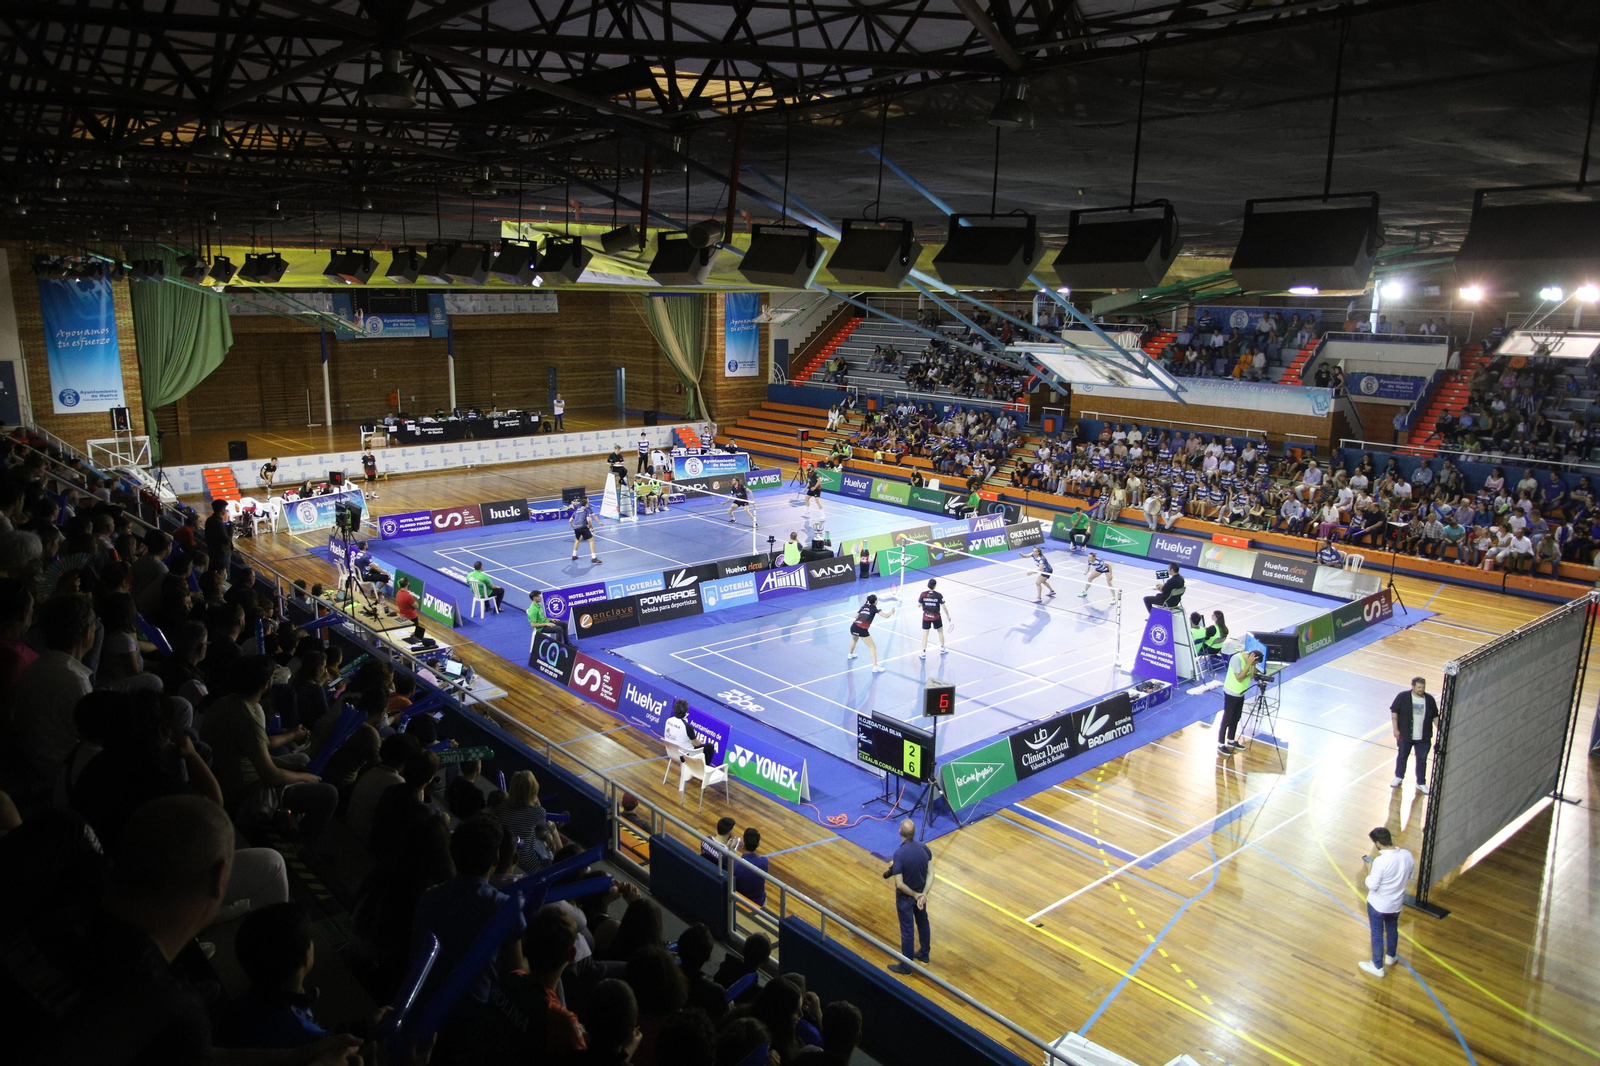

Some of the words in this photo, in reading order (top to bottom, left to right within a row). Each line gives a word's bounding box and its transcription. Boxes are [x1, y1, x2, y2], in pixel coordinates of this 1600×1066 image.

[56, 328, 110, 341] Apoyamos
[58, 340, 70, 348] tu
[72, 338, 110, 351] esfuerzo
[760, 474, 780, 484] YONEX
[844, 478, 867, 489] Huelva
[490, 506, 521, 519] bucle
[945, 525, 968, 534] LOTERÍAS
[1010, 528, 1039, 539] OKEYMAS
[983, 535, 1006, 548] YONEX
[1155, 538, 1192, 555] Huelva
[725, 566, 747, 574] Huelva
[811, 563, 852, 577] VANDA
[1264, 561, 1289, 572] Huelva
[1274, 571, 1305, 584] sentidos.
[626, 578, 662, 591] LOTERÍAS
[720, 580, 754, 592] LOTERÍAS
[568, 598, 588, 607] ALONSO
[588, 595, 607, 604] PINZÓN
[640, 589, 697, 606] POWERADE
[434, 597, 453, 619] YONEX
[593, 606, 633, 619] enclave
[642, 605, 658, 614] bebida
[658, 605, 670, 613] para
[670, 599, 697, 610] deportistas
[1305, 636, 1332, 654] IBERDROLA
[1141, 651, 1157, 660] ALONSO
[1158, 656, 1174, 665] PINZÓN
[1156, 648, 1173, 659] MARTÍN
[625, 683, 662, 716] Huelva
[939, 694, 949, 708] 6
[646, 712, 660, 724] original
[1114, 716, 1132, 726] ESPAÑA
[690, 720, 716, 738] Ayuntamiento
[889, 728, 902, 738] SILVA
[1088, 722, 1134, 749] BADMINTON
[909, 746, 915, 757] 2
[1022, 746, 1046, 766] Clínica
[1047, 737, 1069, 756] Dental
[442, 754, 465, 764] YONE
[1030, 759, 1047, 771] Valverde
[755, 754, 798, 791] YONEX
[908, 762, 915, 773] 6
[957, 777, 963, 787] El
[962, 773, 976, 785] Corte
[974, 765, 993, 783] Inglés
